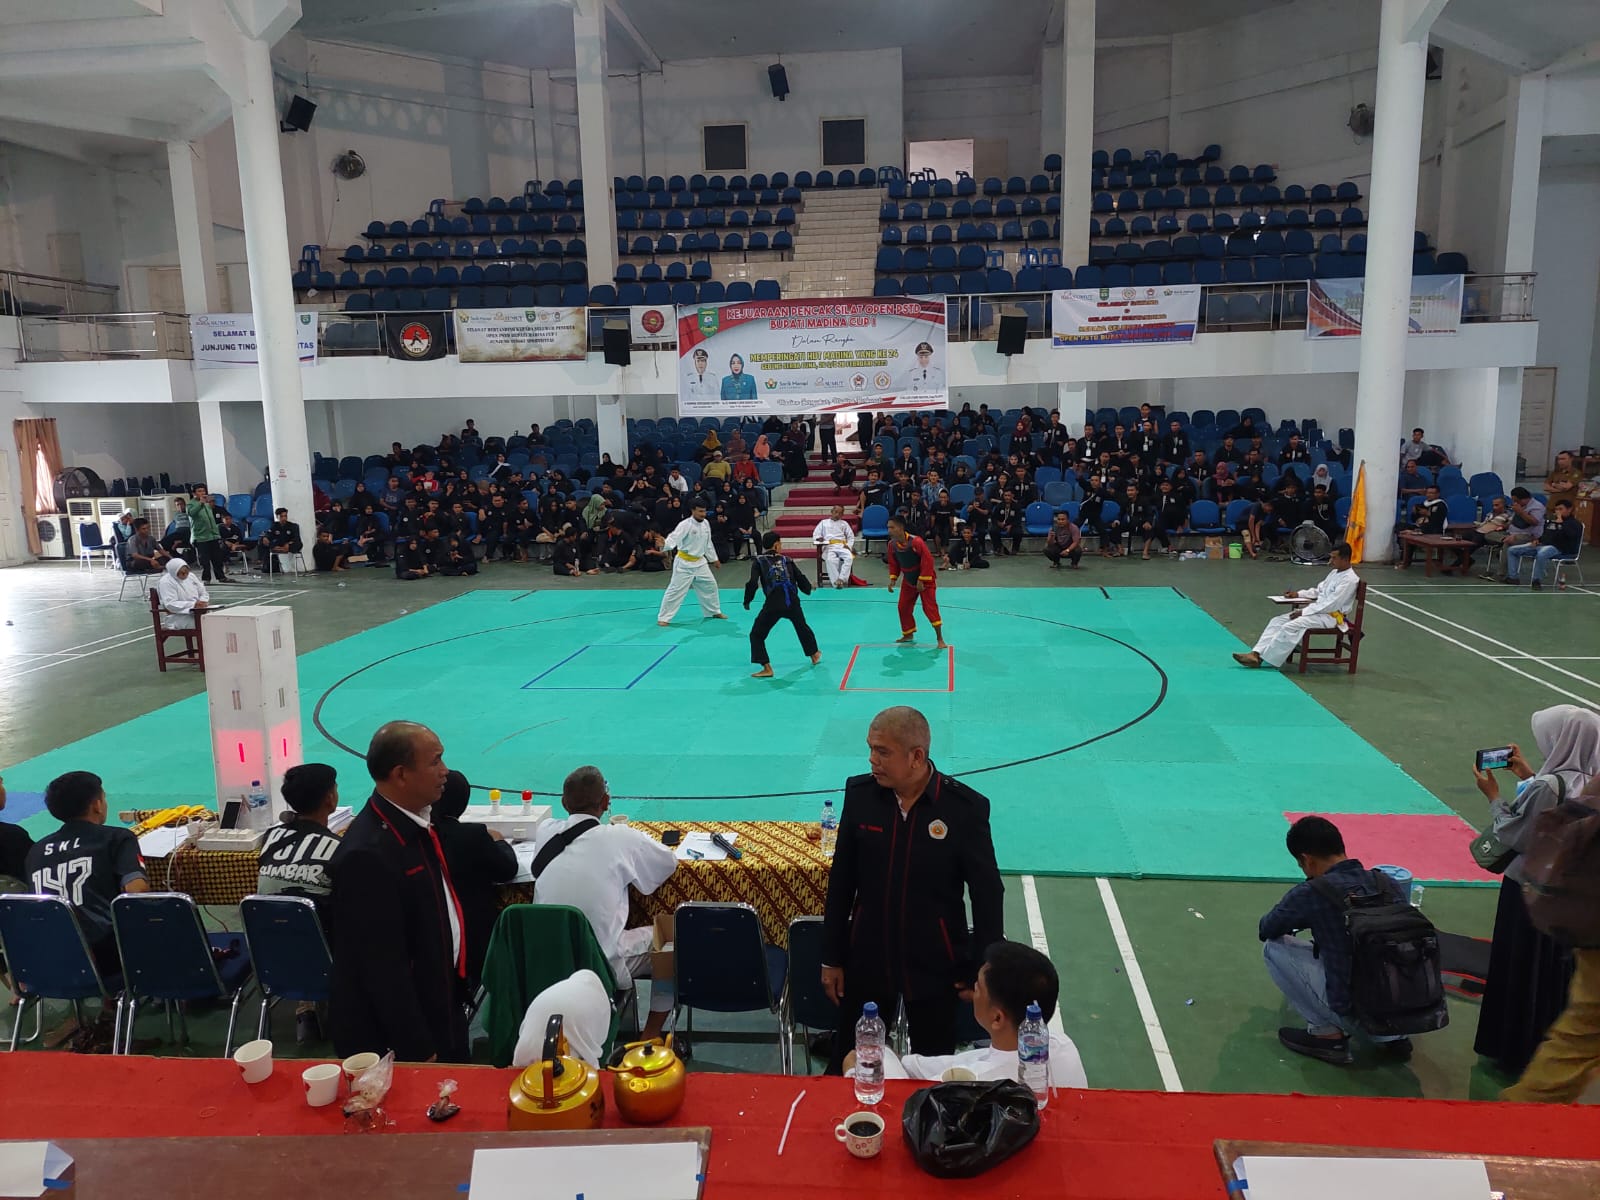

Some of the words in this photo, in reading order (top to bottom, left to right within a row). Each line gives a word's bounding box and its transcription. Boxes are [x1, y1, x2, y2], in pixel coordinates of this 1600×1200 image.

[726, 306, 790, 320] KEJUARAAN
[790, 304, 834, 317] PENCAK
[834, 303, 864, 316] SILAT
[865, 303, 895, 315] OPEN
[895, 303, 921, 314] PSTD
[769, 318, 805, 330] BUPATI
[806, 317, 848, 329] MADINA
[849, 316, 871, 328] CUP
[200, 343, 236, 351] JUNJUNG
[750, 352, 806, 362] MEMPERINGATI
[806, 351, 822, 360] HUT
[823, 350, 854, 360] MADINA
[855, 350, 876, 359] YANG
[877, 349, 887, 358] KE
[887, 349, 899, 358] 24
[31, 856, 93, 907] 147
